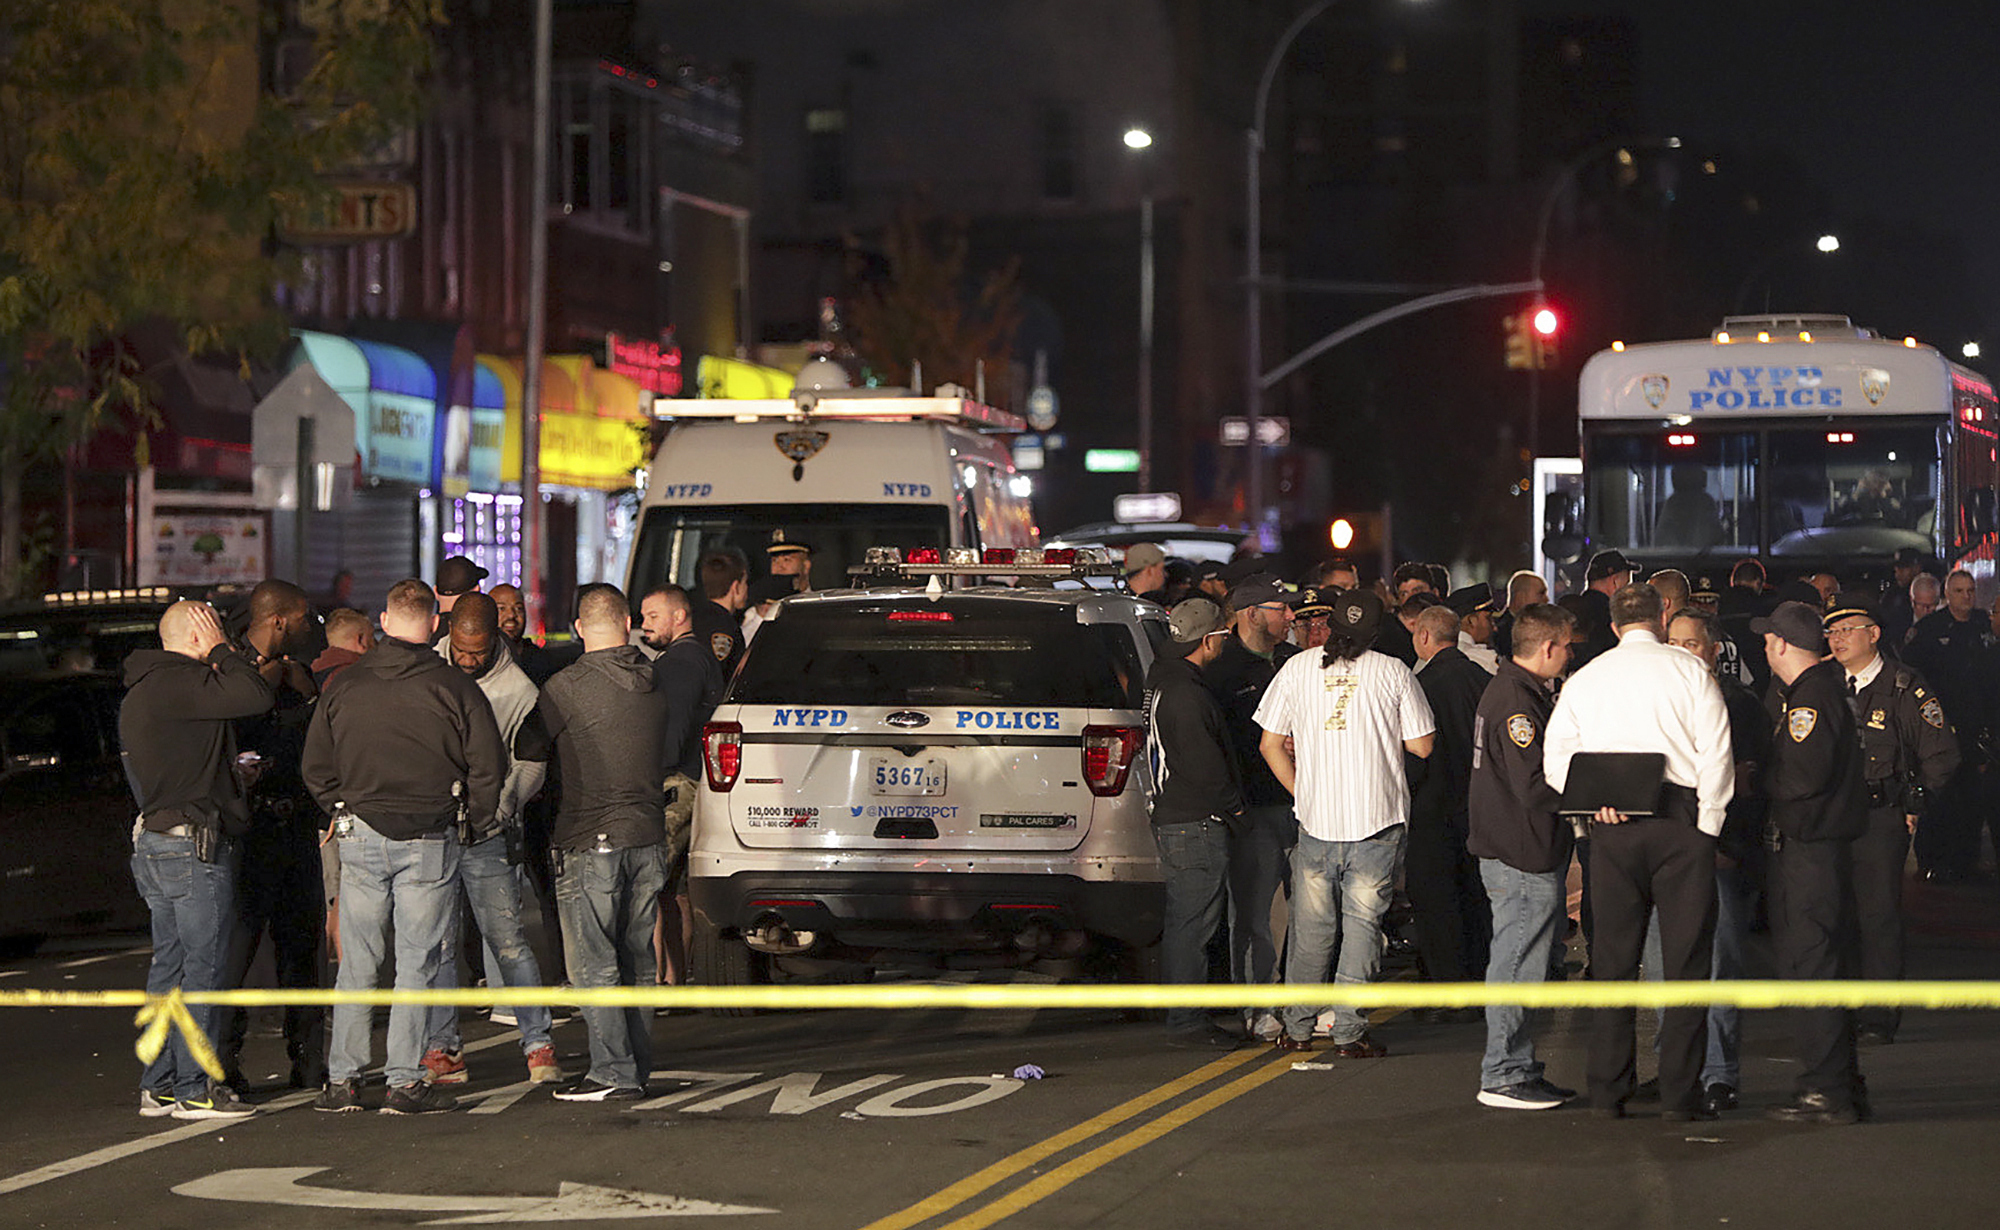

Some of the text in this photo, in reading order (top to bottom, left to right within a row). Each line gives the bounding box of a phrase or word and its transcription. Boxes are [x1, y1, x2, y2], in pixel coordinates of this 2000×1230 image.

[1706, 365, 1823, 388] NYPD
[1688, 387, 1843, 411] POLICE
[665, 484, 712, 498] NYPD
[883, 482, 932, 498] NYPD
[773, 709, 848, 726] NYPD
[956, 711, 1060, 729] POLICE
[876, 767, 939, 786] 5367 16
[748, 806, 819, 817] $10,000 REWARD
[866, 806, 959, 818] @NYPD73PCT
[1009, 817, 1054, 825] PAL CARES
